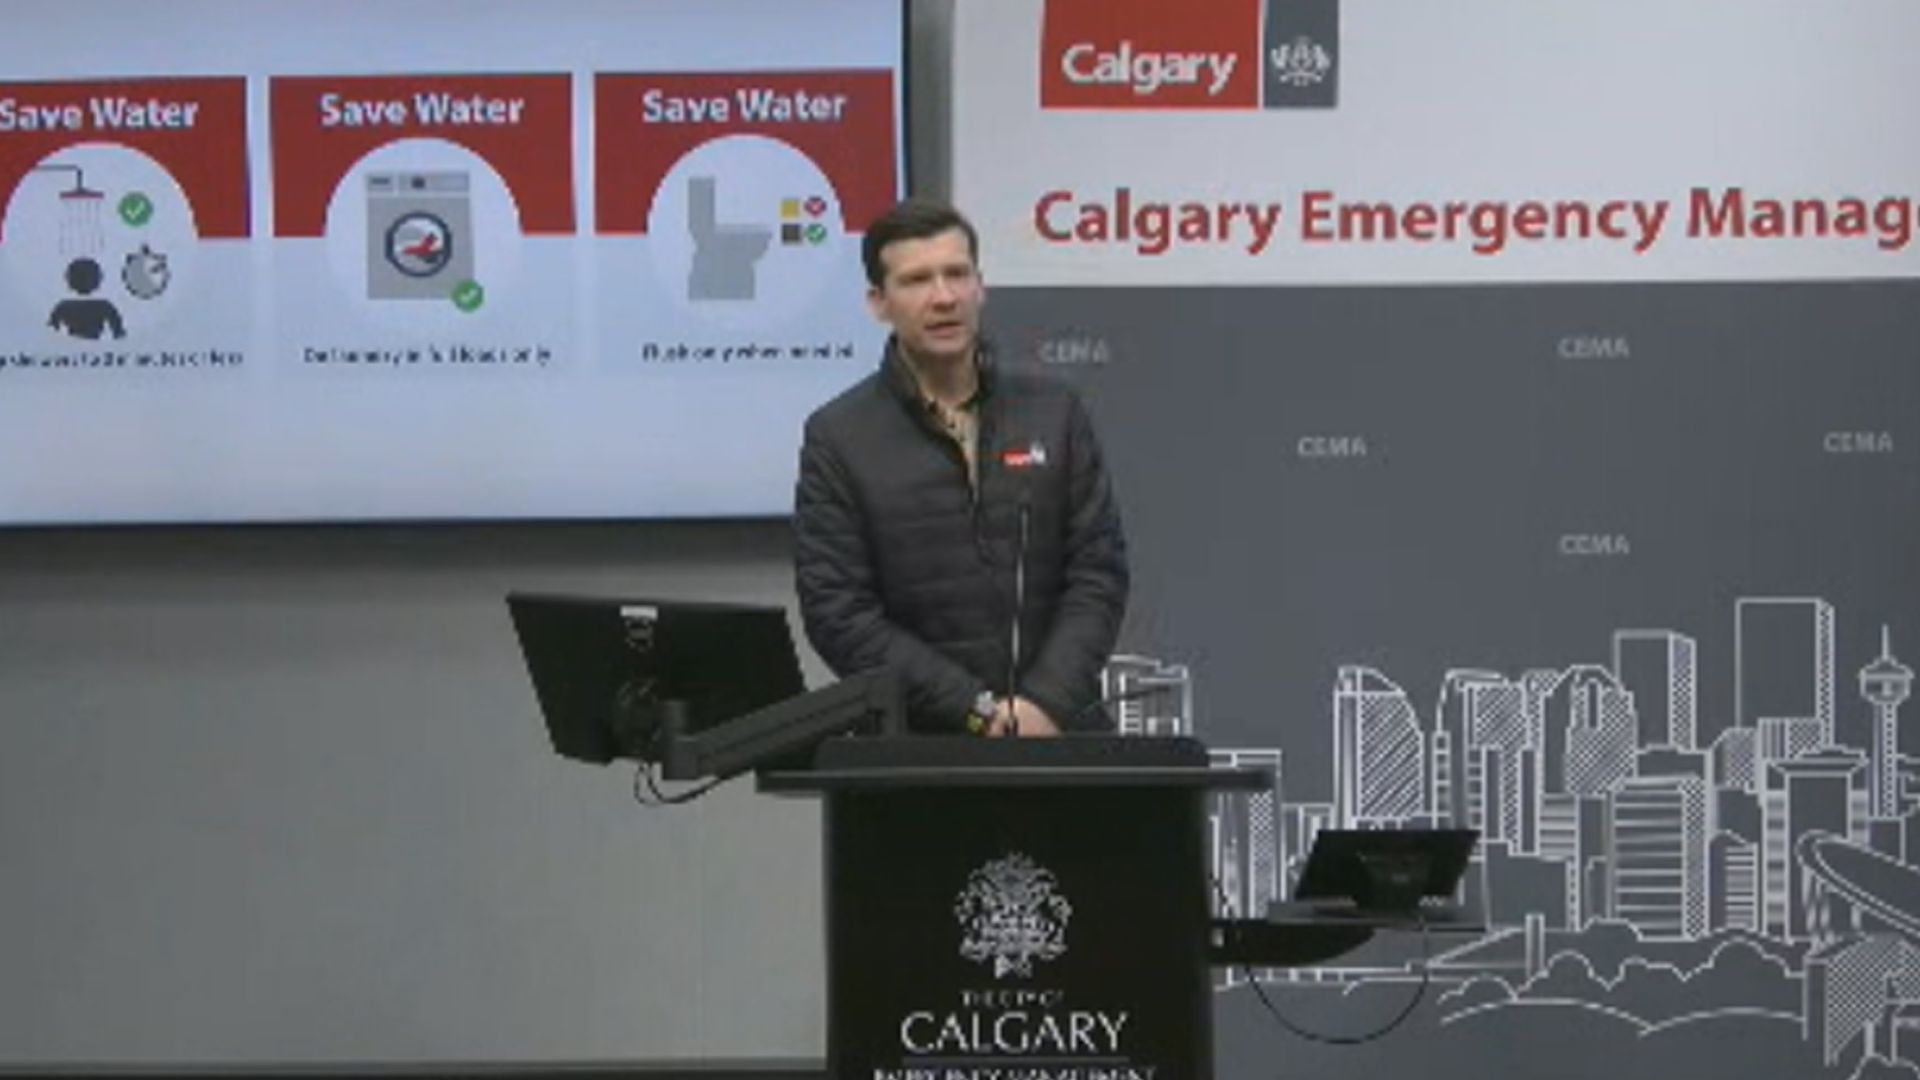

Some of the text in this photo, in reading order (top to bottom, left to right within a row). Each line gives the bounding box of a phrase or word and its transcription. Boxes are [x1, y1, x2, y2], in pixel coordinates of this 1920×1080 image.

[1061, 42, 1237, 95] Calgary
[0, 97, 198, 130] Save Water
[320, 92, 524, 127] Save Water
[642, 88, 846, 122] Save Water
[1034, 187, 1920, 256] Calgary Emergency Manag
[1558, 337, 1630, 358] CEMA
[1297, 436, 1366, 457] CEMA
[1824, 432, 1893, 452] CEMA
[1559, 534, 1630, 555] CEMA
[900, 1010, 1128, 1053] CALGARY
